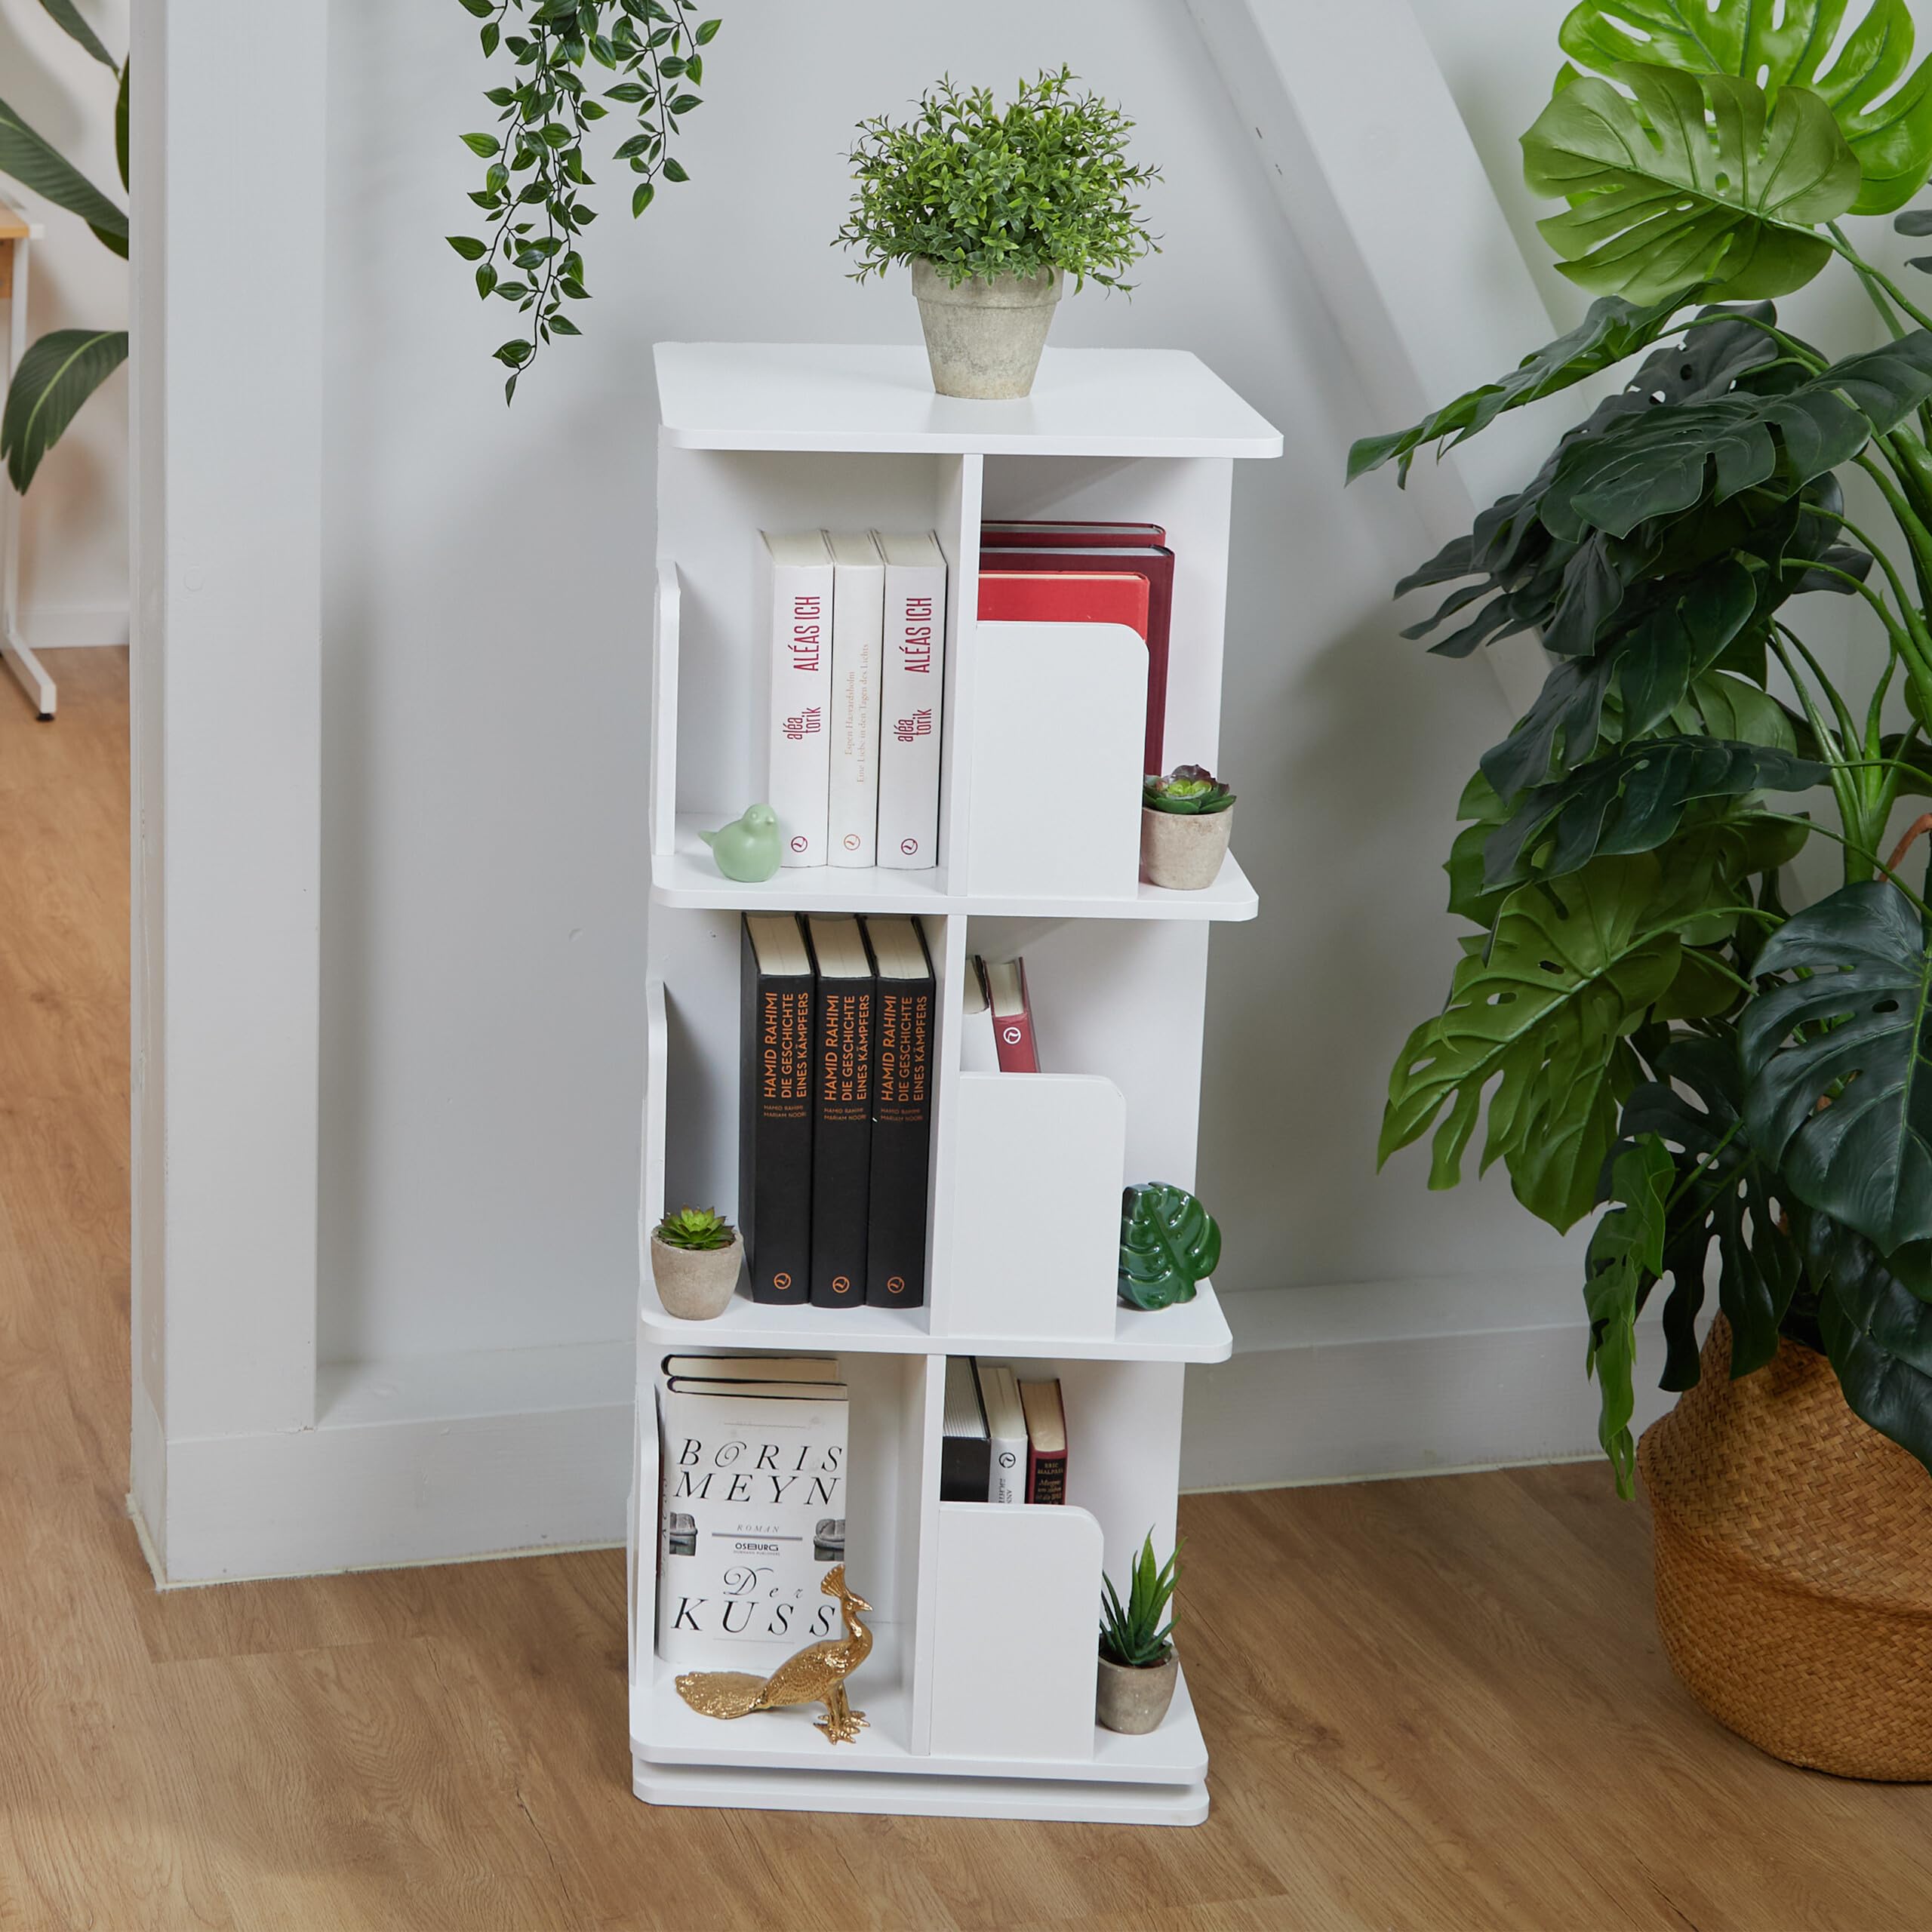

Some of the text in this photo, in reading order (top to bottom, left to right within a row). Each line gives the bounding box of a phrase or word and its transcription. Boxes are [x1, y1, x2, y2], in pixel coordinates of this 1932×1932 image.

[787, 596, 820, 671] ALÉAS ICH
[899, 598, 932, 673] ALÉAS ICH
[783, 718, 803, 740] aléa
[801, 707, 820, 733] torik
[894, 719, 914, 742] aléa
[912, 709, 931, 735] torik
[764, 992, 777, 1097] HAMID RAHIMI
[781, 994, 793, 1097] DIE GESCHICHTE
[796, 992, 808, 1097] EINES KÄMPFERS
[824, 995, 838, 1100] HAMID RAHIMI
[841, 996, 854, 1100] DIE GESCHICHTE
[857, 995, 869, 1100] EINES KÄMPFERS
[881, 995, 897, 1100] HAMID RAHIMI
[899, 997, 912, 1101] DIE GESCHICHTE
[913, 996, 927, 1100] EINES KÄMPFERS
[675, 1470, 841, 1506] MEYN
[676, 1438, 842, 1472] BORIS
[735, 1542, 779, 1552] OSBURG
[737, 1524, 780, 1533] ROMAN
[670, 1596, 836, 1638] KUSS
[723, 1566, 804, 1598] Der
